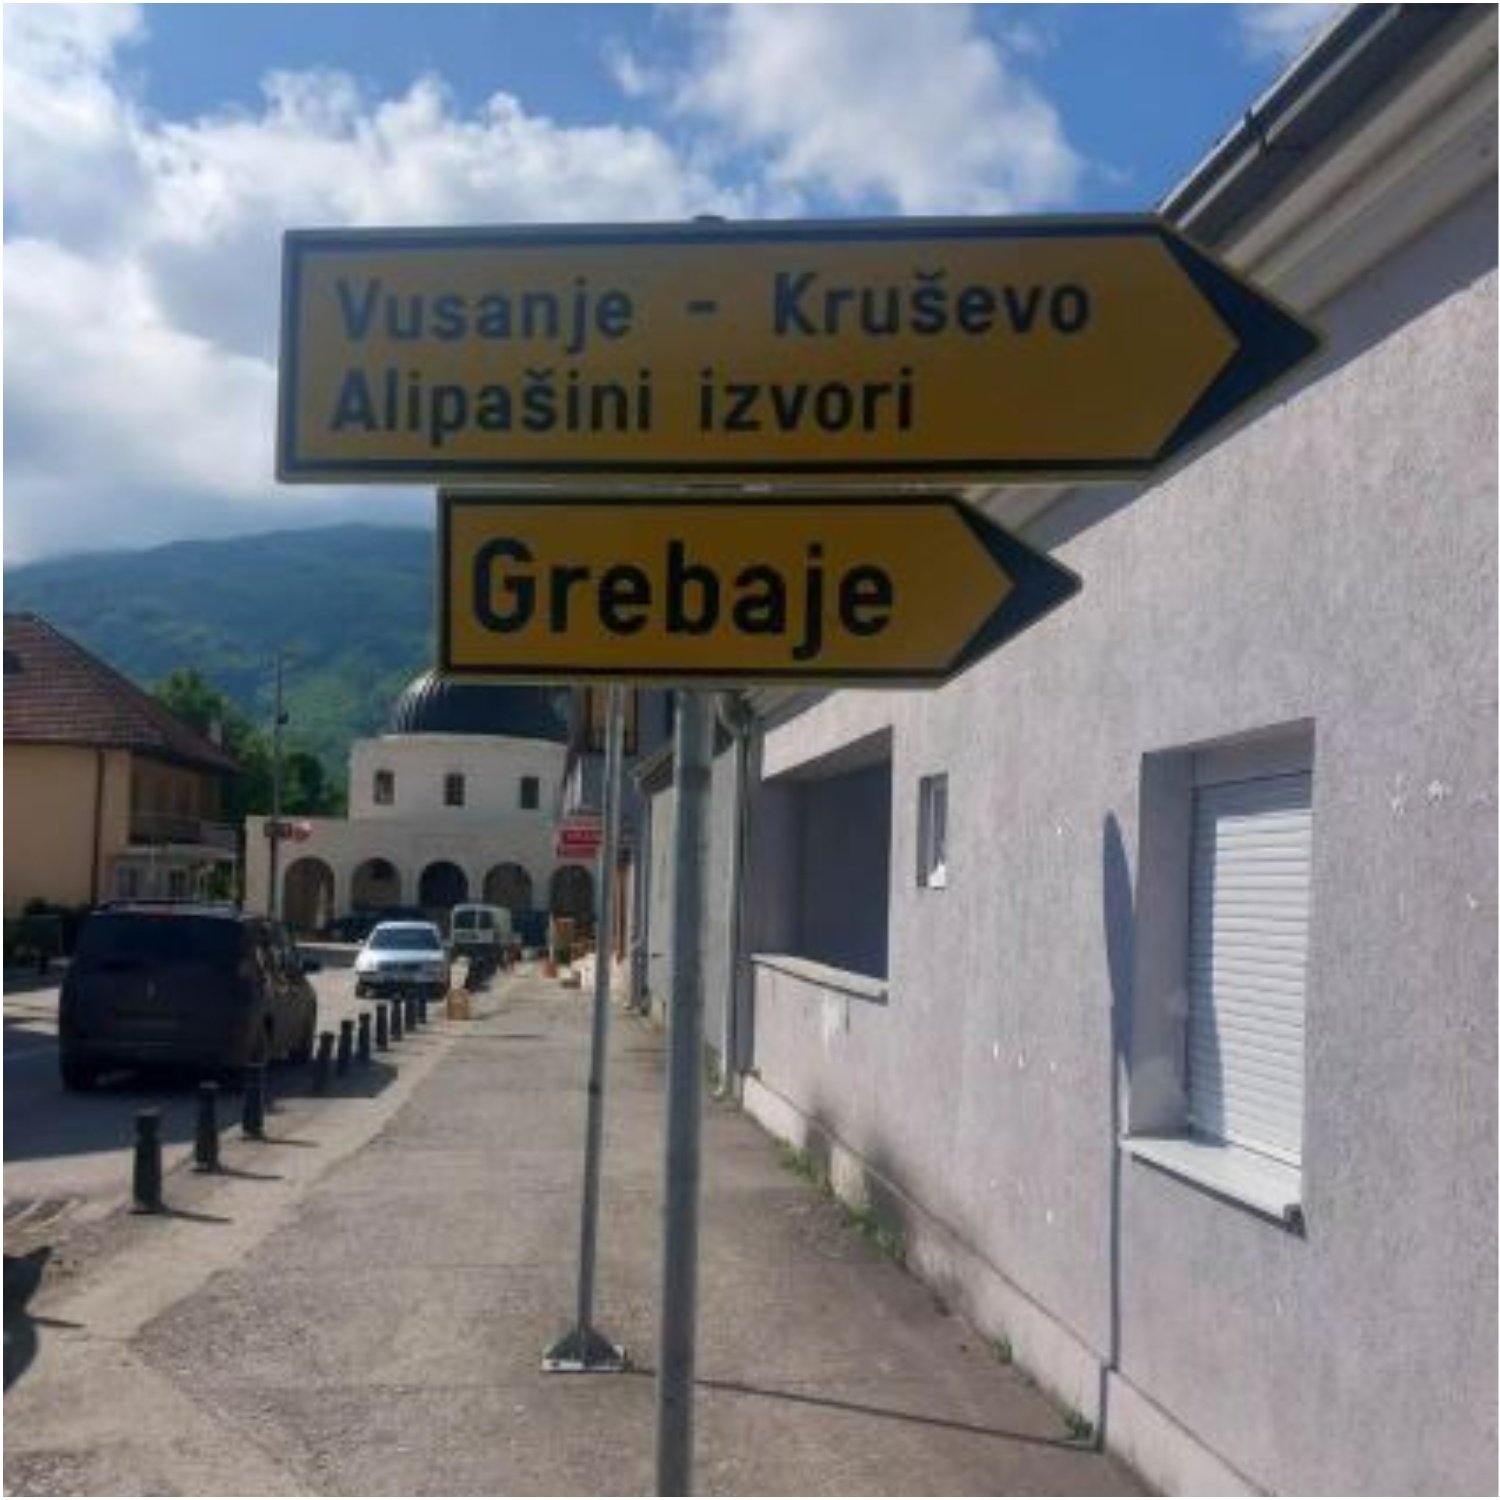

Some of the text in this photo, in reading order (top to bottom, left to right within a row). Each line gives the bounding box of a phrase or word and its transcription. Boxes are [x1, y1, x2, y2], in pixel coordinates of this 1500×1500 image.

[336, 267, 1090, 354] Vusanje - Kruševo
[330, 367, 914, 447] Alipašini izvori
[472, 537, 894, 661] Grebaje
